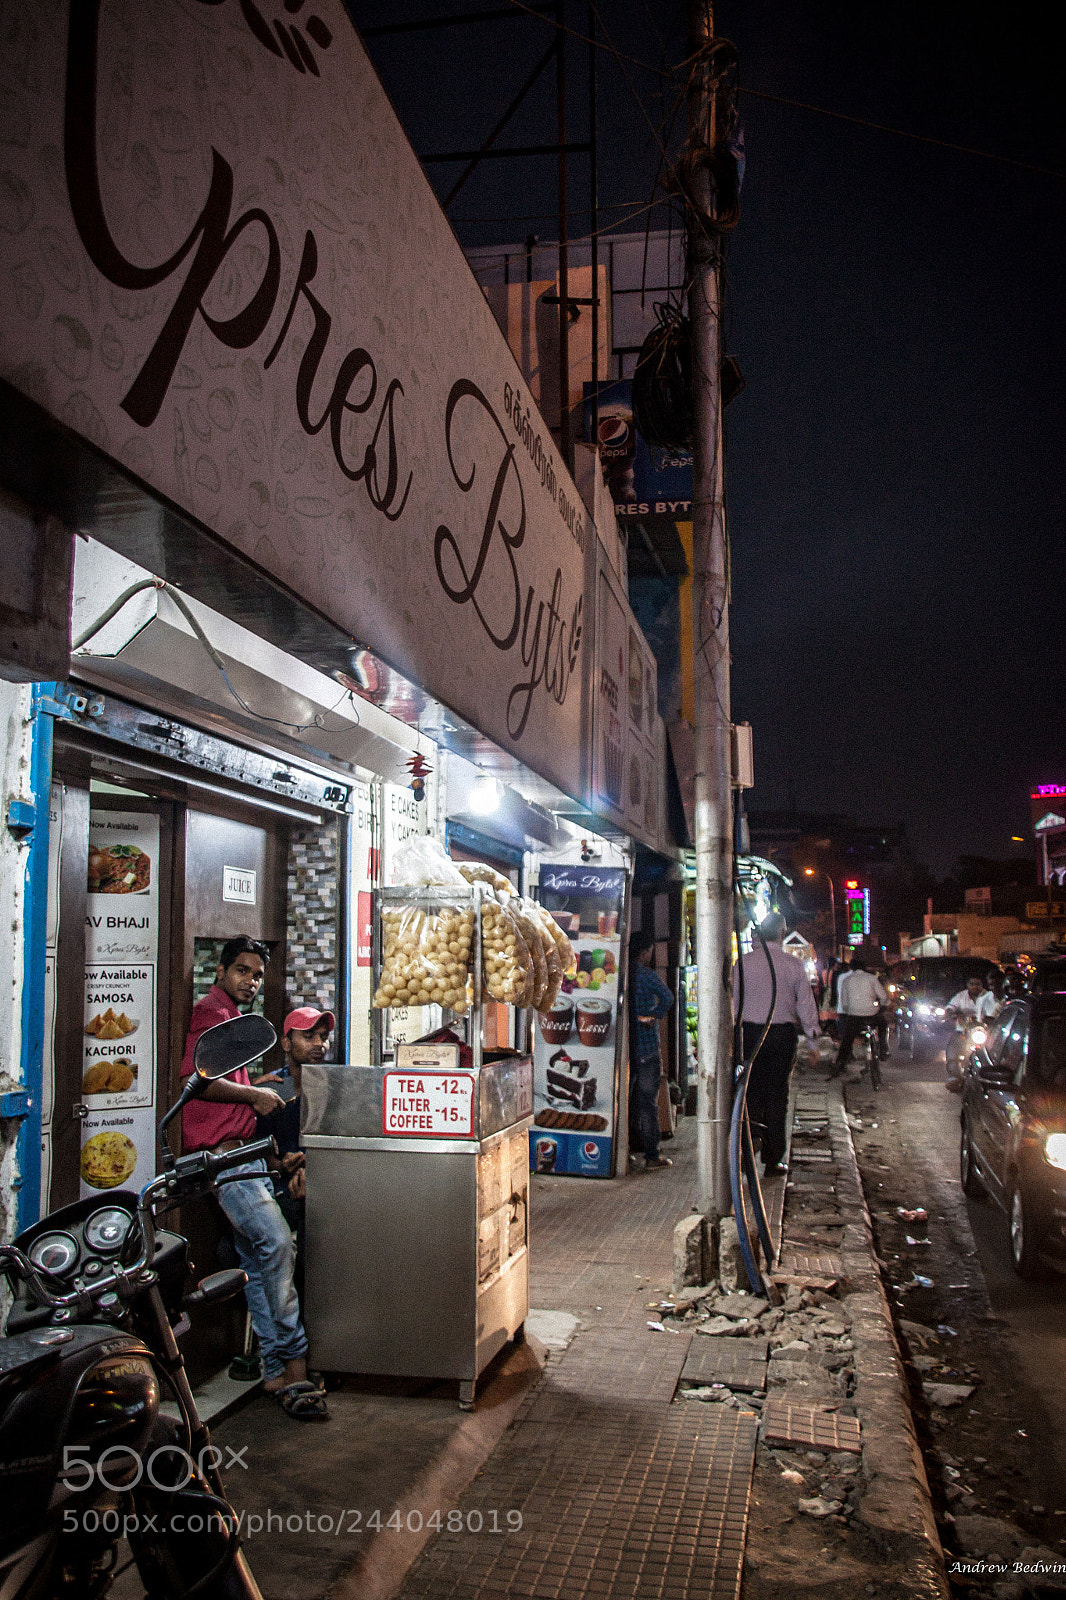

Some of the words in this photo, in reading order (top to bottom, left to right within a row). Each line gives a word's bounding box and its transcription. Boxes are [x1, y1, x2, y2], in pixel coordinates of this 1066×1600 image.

[599, 446, 628, 458] pepsi
[615, 502, 650, 515] RES
[655, 500, 692, 513] BYT
[106, 822, 139, 831] Available
[229, 877, 252, 894] JUICE
[541, 871, 577, 889] Xpres
[85, 917, 102, 928] AV
[106, 917, 150, 929] BHAJI
[100, 970, 148, 980] Available
[87, 993, 134, 1004] SAMOSA
[541, 1019, 571, 1031] Sweet
[85, 1045, 136, 1057] KACHORI
[398, 1080, 425, 1093] TEA
[435, 1080, 459, 1094] -12
[392, 1098, 430, 1112] FILTER
[435, 1107, 458, 1122] -15
[82, 1120, 99, 1128] Now
[101, 1117, 134, 1126] Available
[389, 1114, 433, 1129] COFFEE
